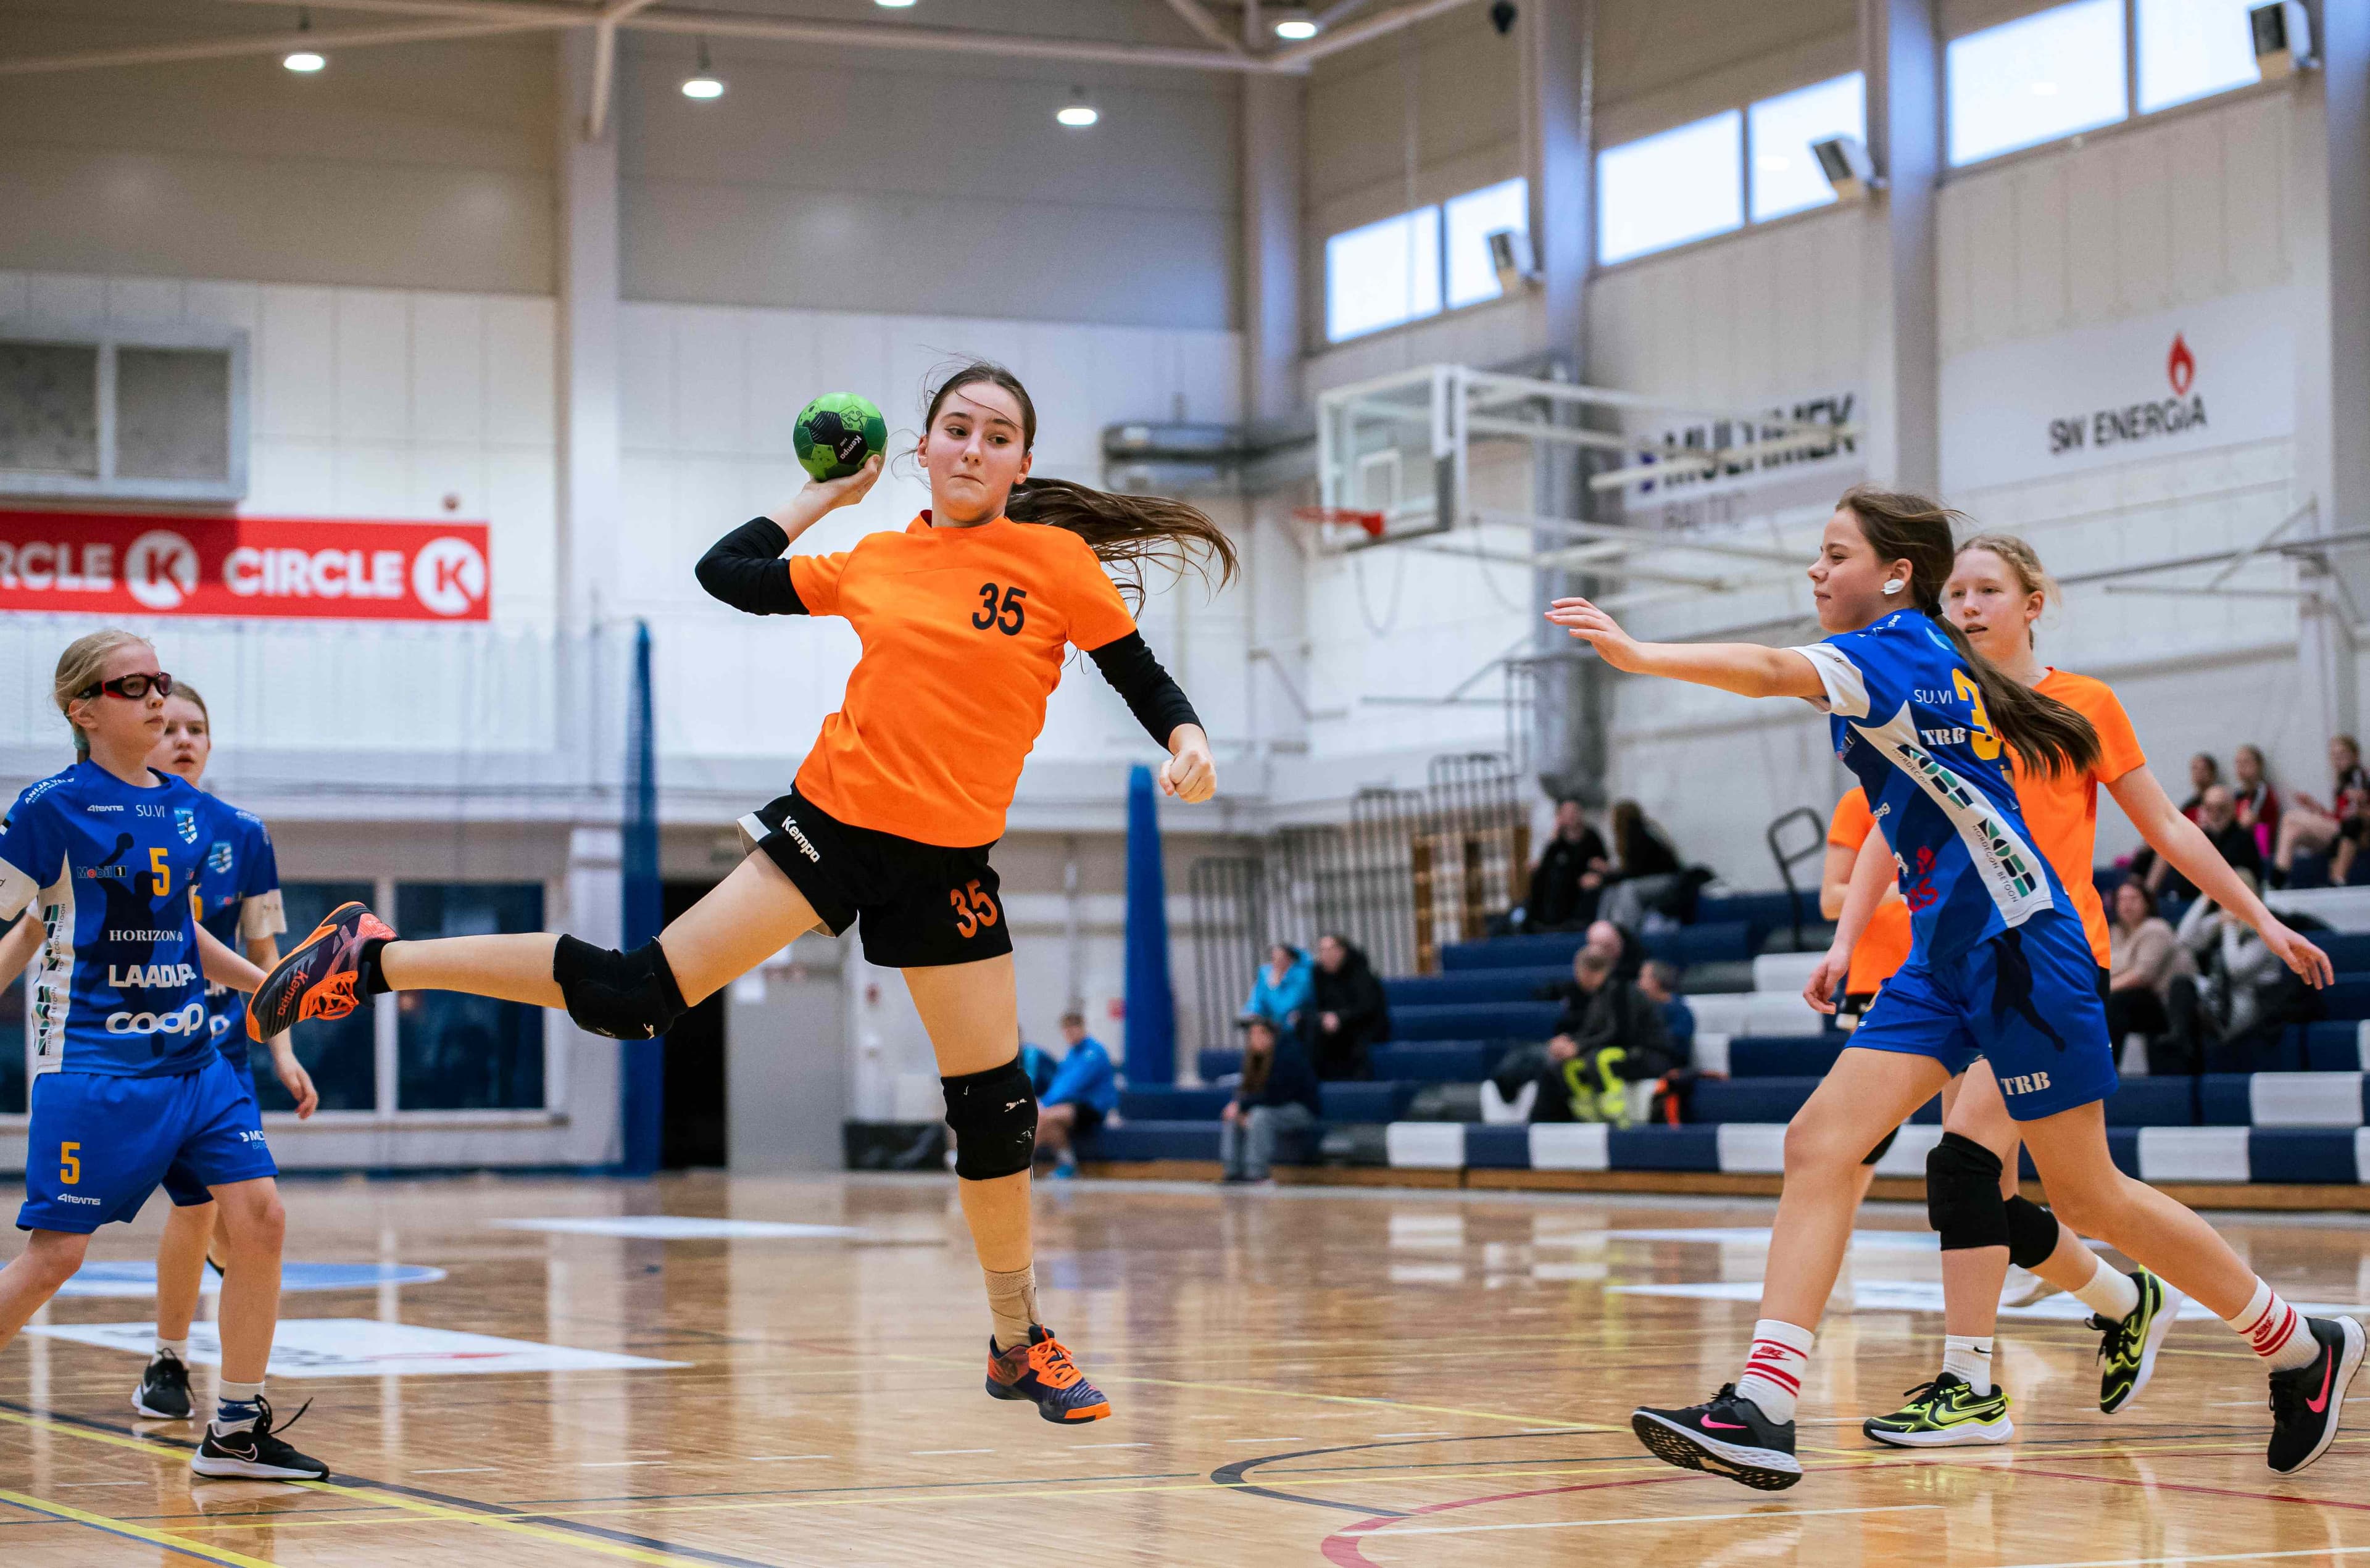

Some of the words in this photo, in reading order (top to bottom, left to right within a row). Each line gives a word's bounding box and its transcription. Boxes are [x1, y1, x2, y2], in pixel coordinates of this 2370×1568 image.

[840, 435, 862, 460] Kempa
[222, 547, 405, 599] CIRCLE
[972, 583, 1027, 636] 35
[1914, 689, 1953, 704] SU.VI
[1921, 727, 1966, 745] TRB
[25, 781, 49, 804] ANIJA
[136, 805, 165, 818] SU.VI
[781, 816, 820, 863] Kempa
[149, 848, 170, 897] 5
[1972, 825, 1999, 869] NORDECON
[1997, 871, 2019, 902] BETOON
[950, 879, 998, 938] 35
[109, 930, 175, 941] HORIZON
[278, 970, 309, 1016] Kempa
[2000, 1071, 2051, 1095] TRB
[60, 1142, 80, 1184] 5
